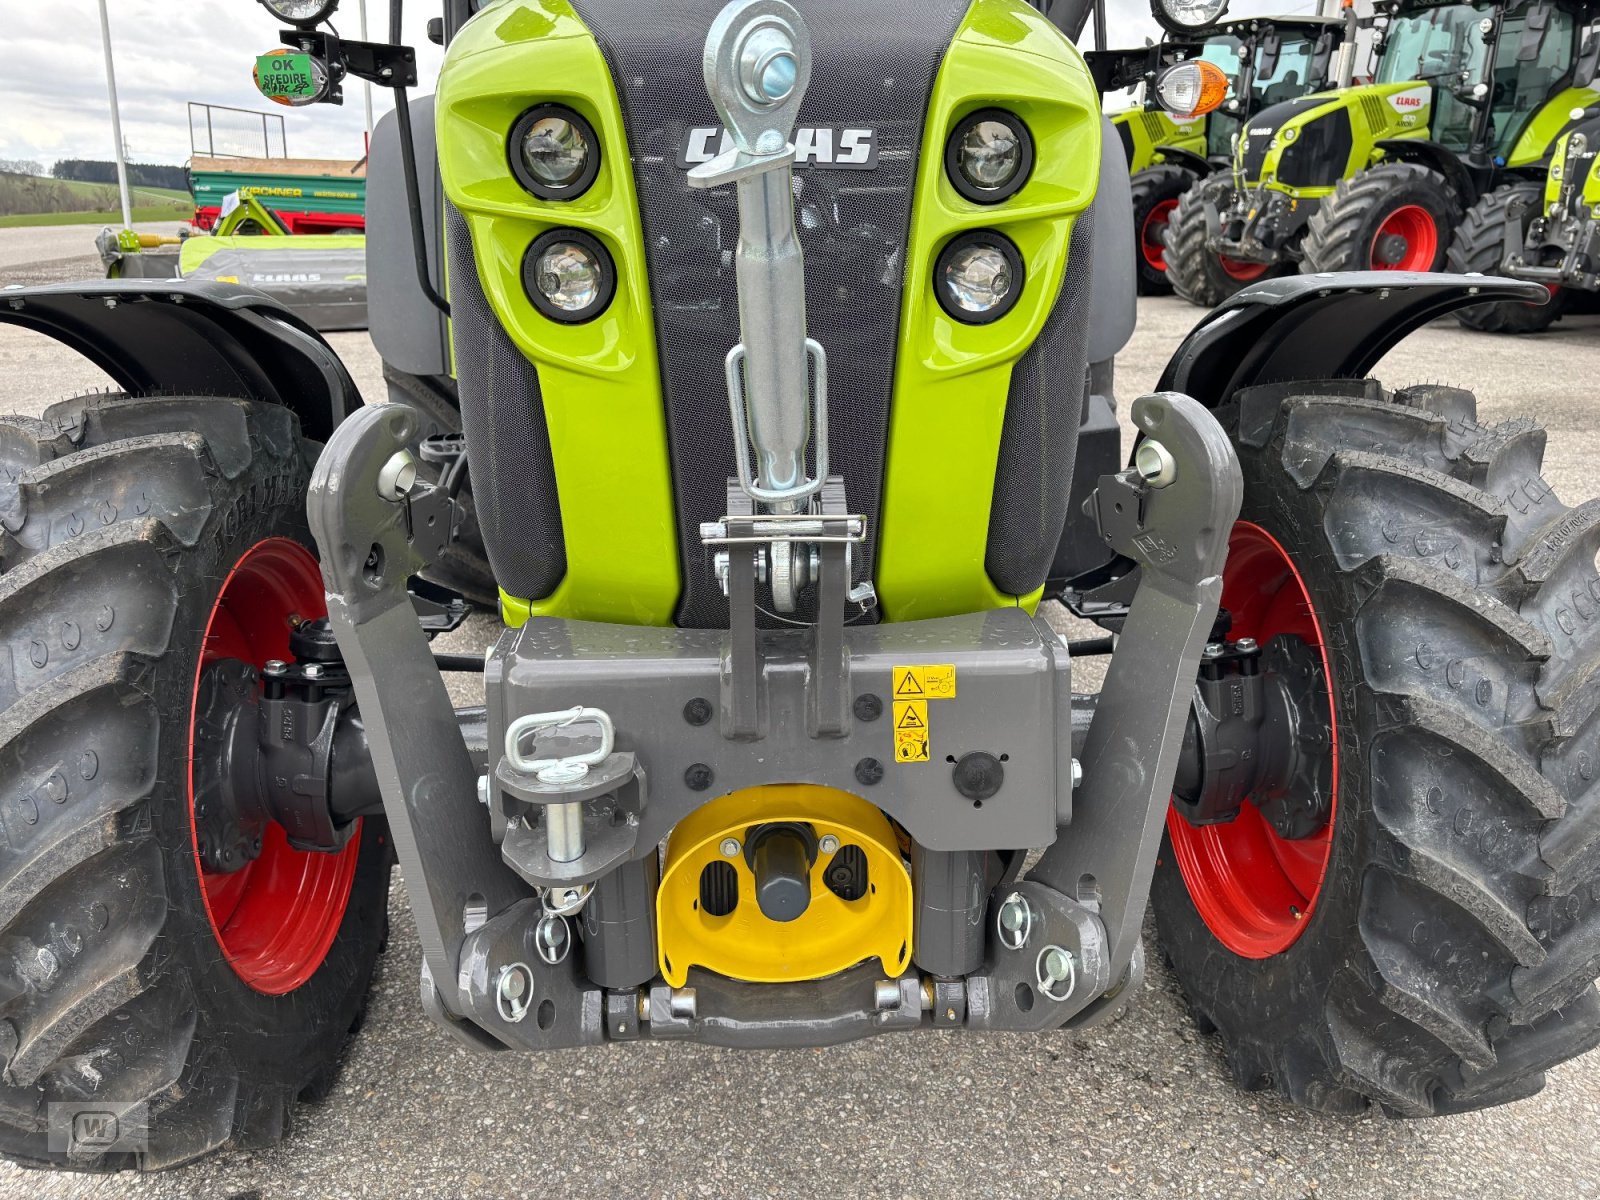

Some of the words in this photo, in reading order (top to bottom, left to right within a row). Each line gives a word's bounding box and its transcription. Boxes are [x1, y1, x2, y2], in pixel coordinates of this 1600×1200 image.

[272, 60, 294, 71] OK
[264, 73, 306, 85] SPEDIRE
[1395, 97, 1421, 106] CLAAS
[685, 127, 873, 164] CAS
[241, 186, 302, 197] KIRCHNER
[253, 274, 320, 282] CLAAS
